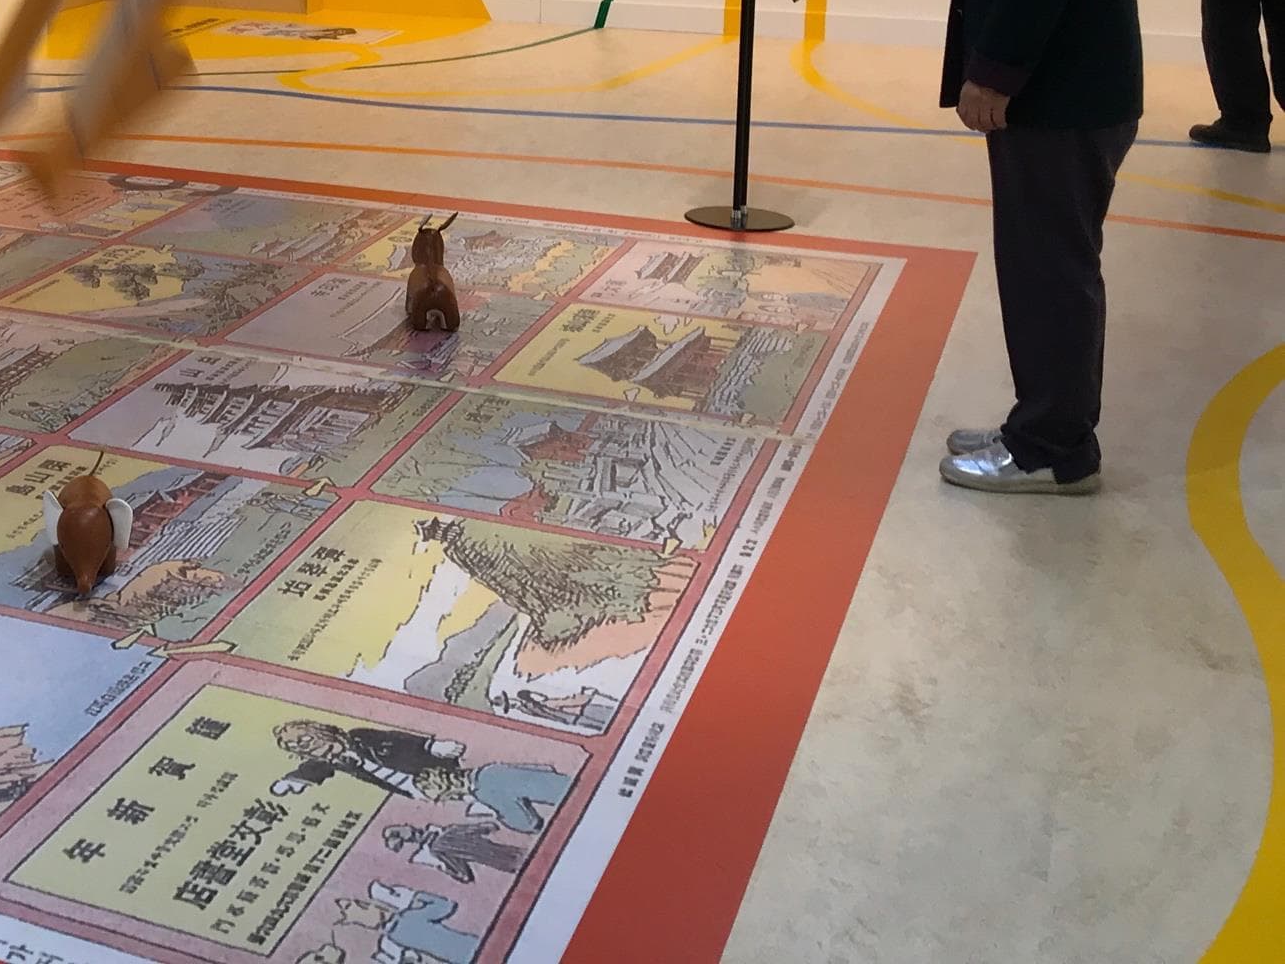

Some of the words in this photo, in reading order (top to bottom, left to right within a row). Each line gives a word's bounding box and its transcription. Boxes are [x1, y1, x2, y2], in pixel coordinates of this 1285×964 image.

[62, 716, 231, 864] 謹賀新年
[173, 797, 289, 911] 彰文堂書店
